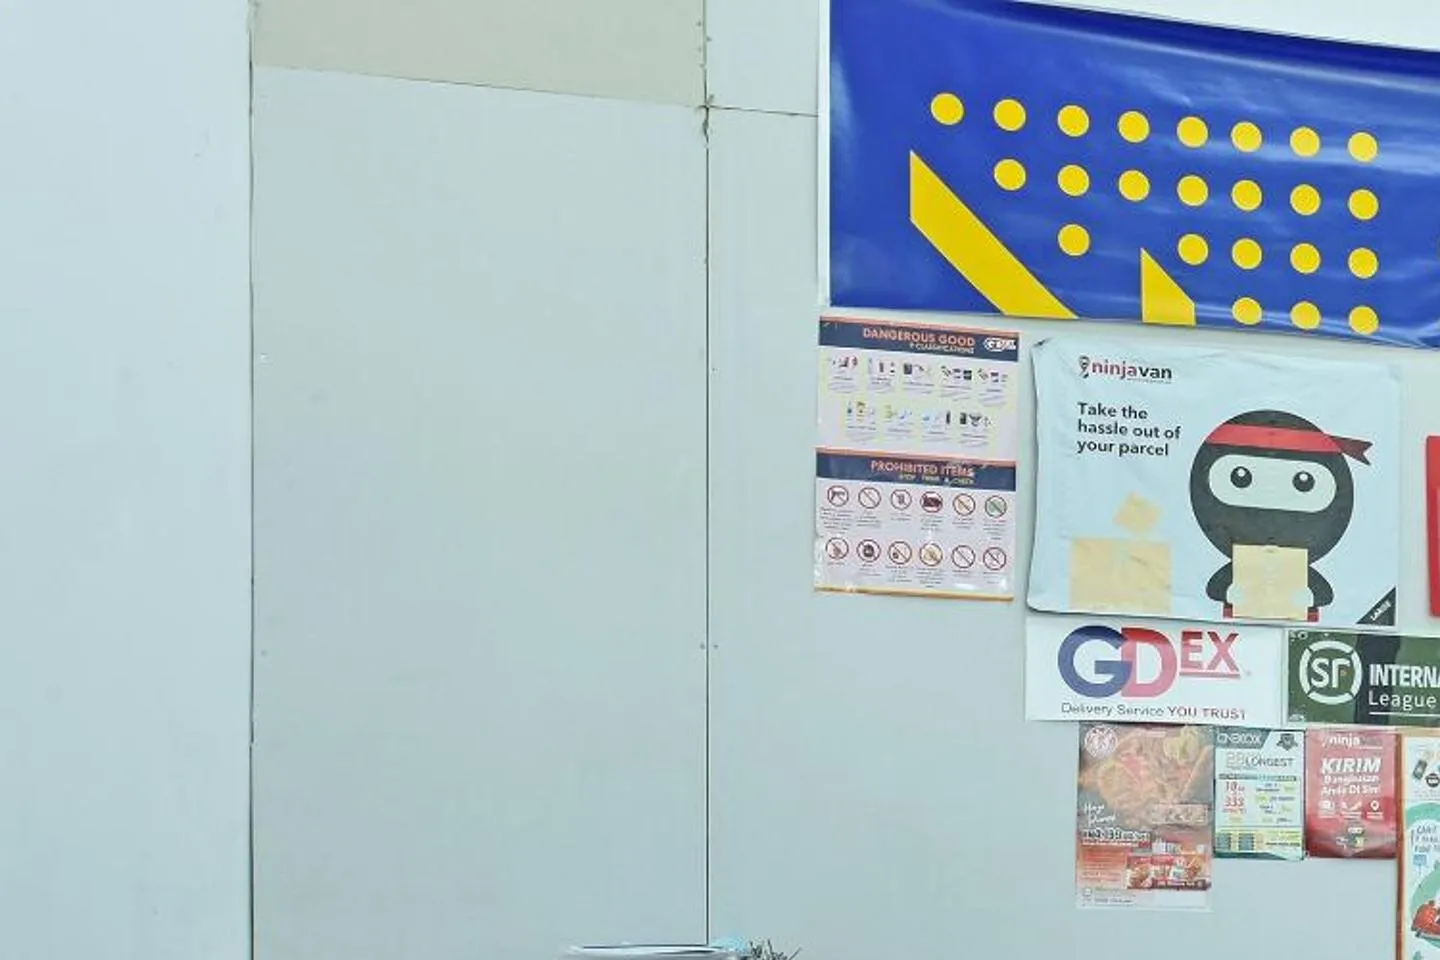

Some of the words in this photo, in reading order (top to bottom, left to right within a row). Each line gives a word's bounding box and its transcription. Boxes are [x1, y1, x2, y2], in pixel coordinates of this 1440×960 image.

[862, 327, 936, 343] DANGEROUS
[938, 334, 976, 347] GOOD
[1091, 359, 1172, 379] ninjavan
[1077, 402, 1117, 417] Take
[1121, 405, 1148, 419] the
[1078, 418, 1128, 435] hassle
[1132, 426, 1160, 438] out
[1163, 426, 1181, 439] of
[1077, 440, 1114, 454] your
[1118, 443, 1168, 457] parcel
[871, 460, 938, 476] PROHIBITED
[1368, 690, 1437, 711] League
[1061, 702, 1113, 717] Delivery
[1117, 704, 1164, 717] Service
[1167, 706, 1197, 718] YOU
[1202, 707, 1246, 720] TRUST
[1322, 757, 1381, 774] KIRIM
